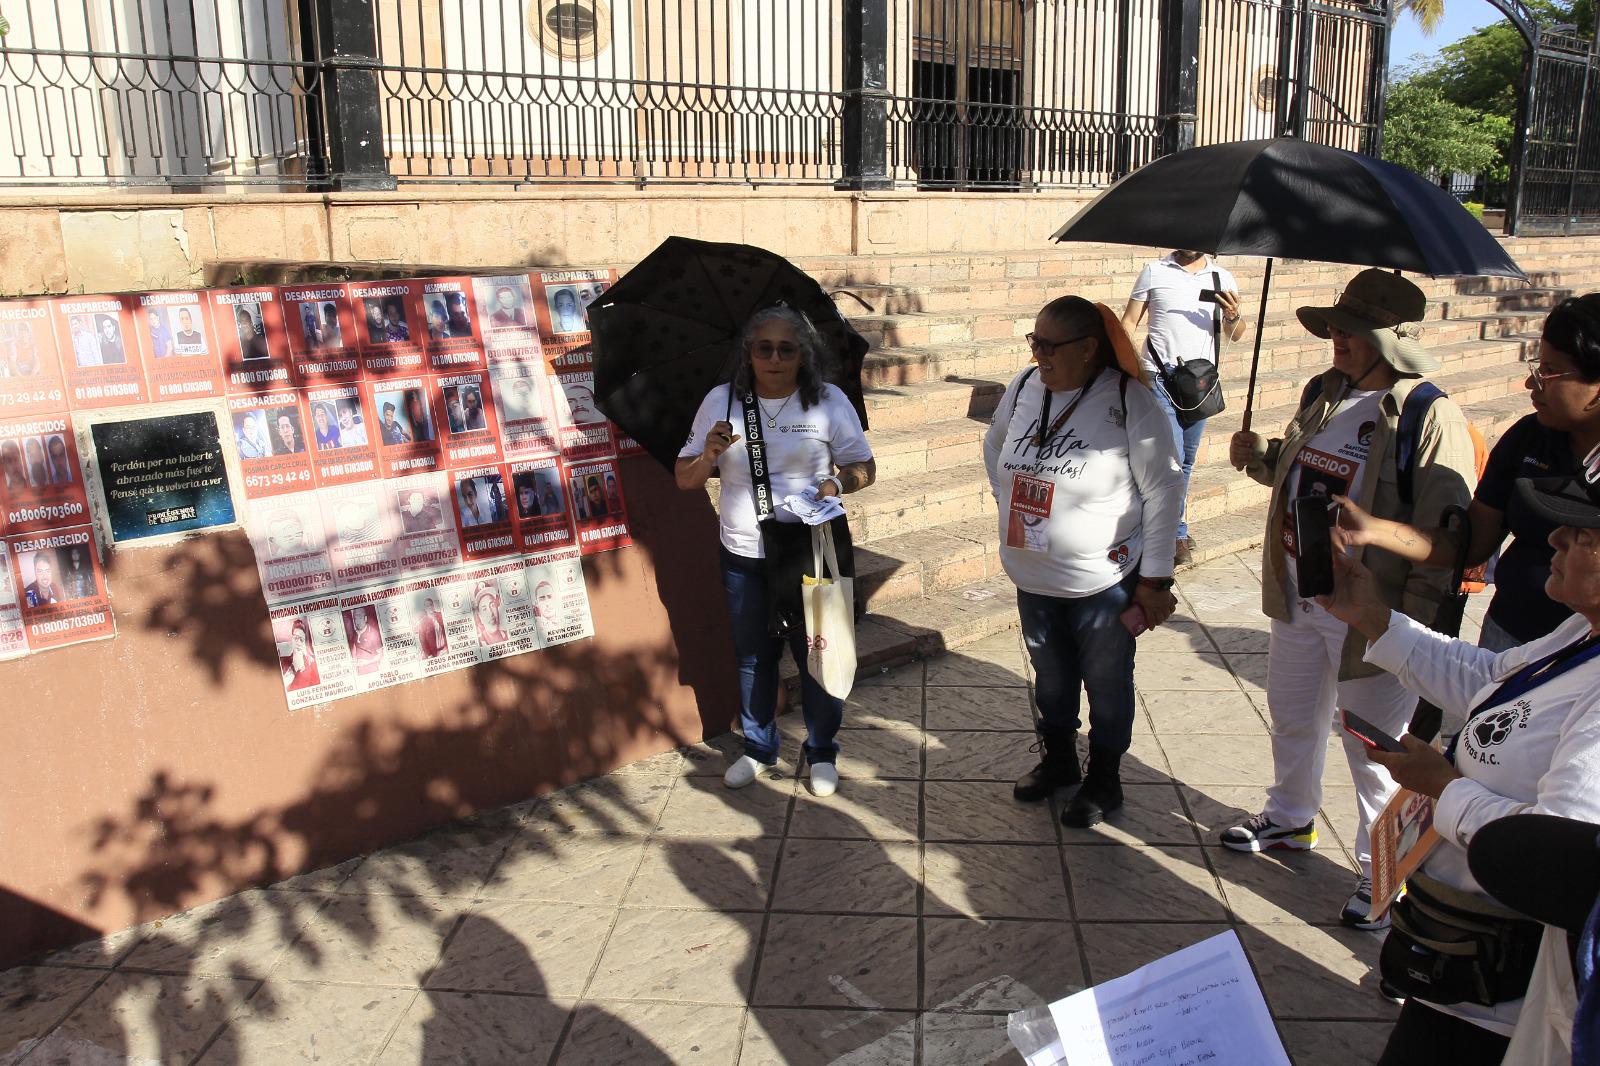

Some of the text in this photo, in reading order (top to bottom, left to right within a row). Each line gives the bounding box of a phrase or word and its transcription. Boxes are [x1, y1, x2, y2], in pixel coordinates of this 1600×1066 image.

[541, 270, 609, 283] DESAPARECIDO
[216, 291, 273, 305] DESAPARECIDO
[285, 288, 345, 302] DESAPARECIDO
[352, 285, 410, 298] DESAPARECIDO
[140, 293, 199, 306] DESAPARECIDO
[0, 308, 46, 320] ARECIDO
[60, 301, 122, 314] DESAPARECIDO
[568, 354, 584, 364] 800
[374, 380, 423, 392] DESAPARECIDO
[437, 375, 482, 387] DESAPARECIDO
[307, 387, 359, 400] DESAPARECIDO
[230, 393, 296, 409] DESAPARECIDO
[0, 420, 67, 437] ESAPARECIDOS
[747, 409, 760, 440] KENZO
[1013, 419, 1090, 461] Hsta
[111, 451, 213, 472] Perdón por no haberte
[511, 459, 557, 473] DESAPARECIDO
[752, 444, 765, 478] KENZO
[1297, 449, 1351, 476] ARECIDO
[116, 464, 212, 486] abrazado más fuerte
[571, 463, 613, 477] DESAPARECIDO
[1003, 459, 1087, 480] encontrarlos!
[245, 469, 311, 487] 6673 29 42 49
[110, 486, 138, 499] Pensé
[139, 485, 155, 498] que
[156, 483, 164, 492] te
[201, 480, 208, 488] a
[209, 476, 222, 487] ver
[14, 533, 90, 553] DESAPARECIDO
[547, 624, 582, 636] KEVIN CRUZ
[547, 630, 585, 643] BETANCOURT
[0, 631, 24, 644] 628
[489, 637, 531, 652] JESUS ERNESTO
[427, 651, 474, 667] JESUS ANTONIO
[452, 656, 479, 668] PAREDES
[368, 672, 414, 689] APOLINAR SOTO
[380, 670, 399, 680] PABLO
[291, 686, 354, 706] GONZALEZ MAURICIO
[296, 682, 344, 698] LUIS FERNANDO
[1479, 751, 1500, 765] A.C.
